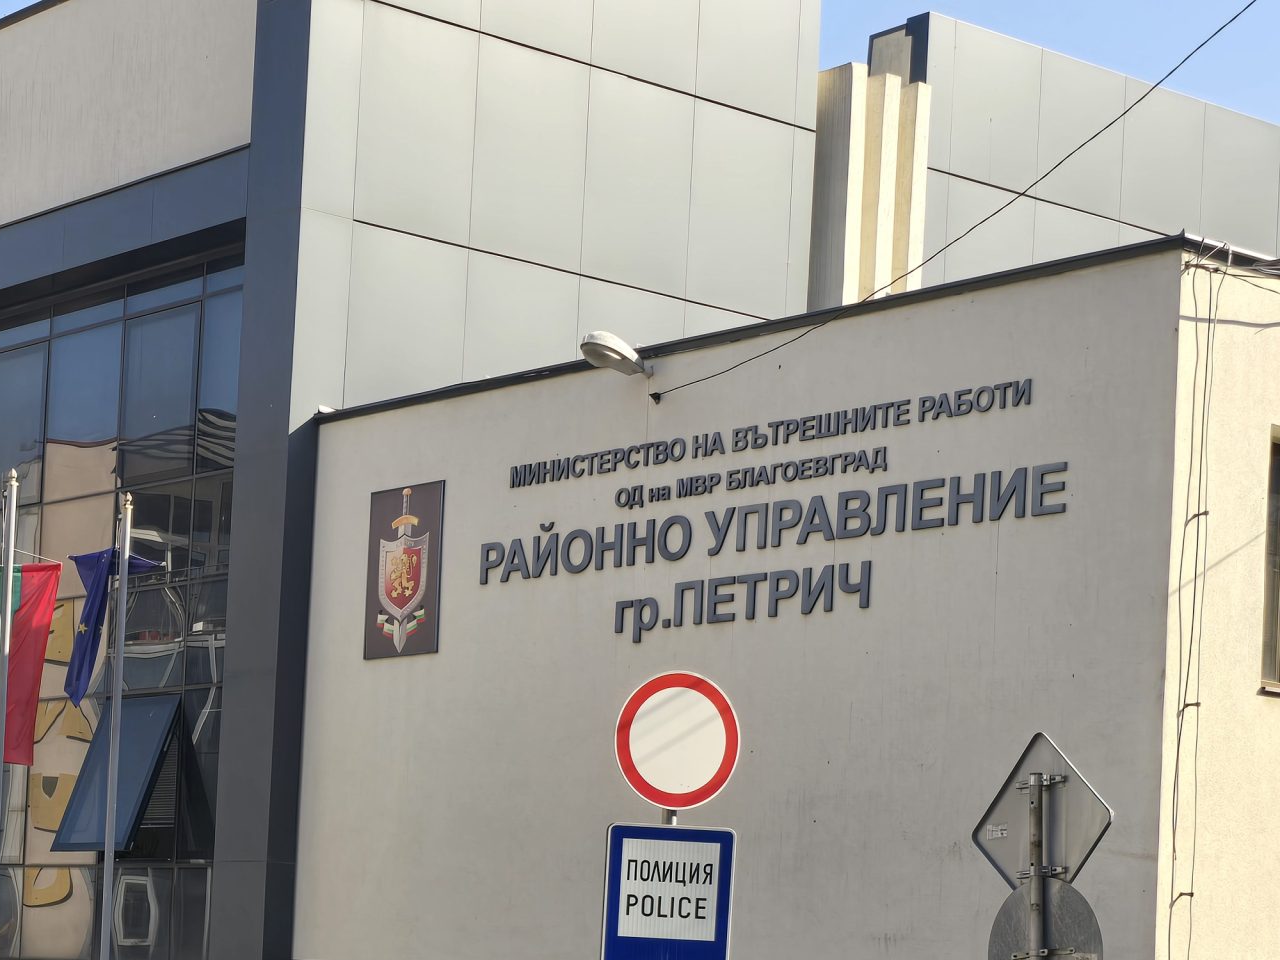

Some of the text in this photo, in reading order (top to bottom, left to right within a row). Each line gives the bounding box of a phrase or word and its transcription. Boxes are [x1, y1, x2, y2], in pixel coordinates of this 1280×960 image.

[509, 377, 1034, 489] МИНИСТЕРСТВО НА ВЪТРЕШНИТЕ РАБОТИ
[614, 446, 889, 509] ОД на МВР БЛАГОЕВГРАД
[479, 513, 693, 586] РАЙОННО
[706, 461, 1069, 557] УПРАВЛЕНИЕ
[614, 560, 872, 645] гр.ПЕТРИЧ
[625, 894, 707, 920] POLICE
[627, 859, 713, 887] ПОЛИЦИЯ
